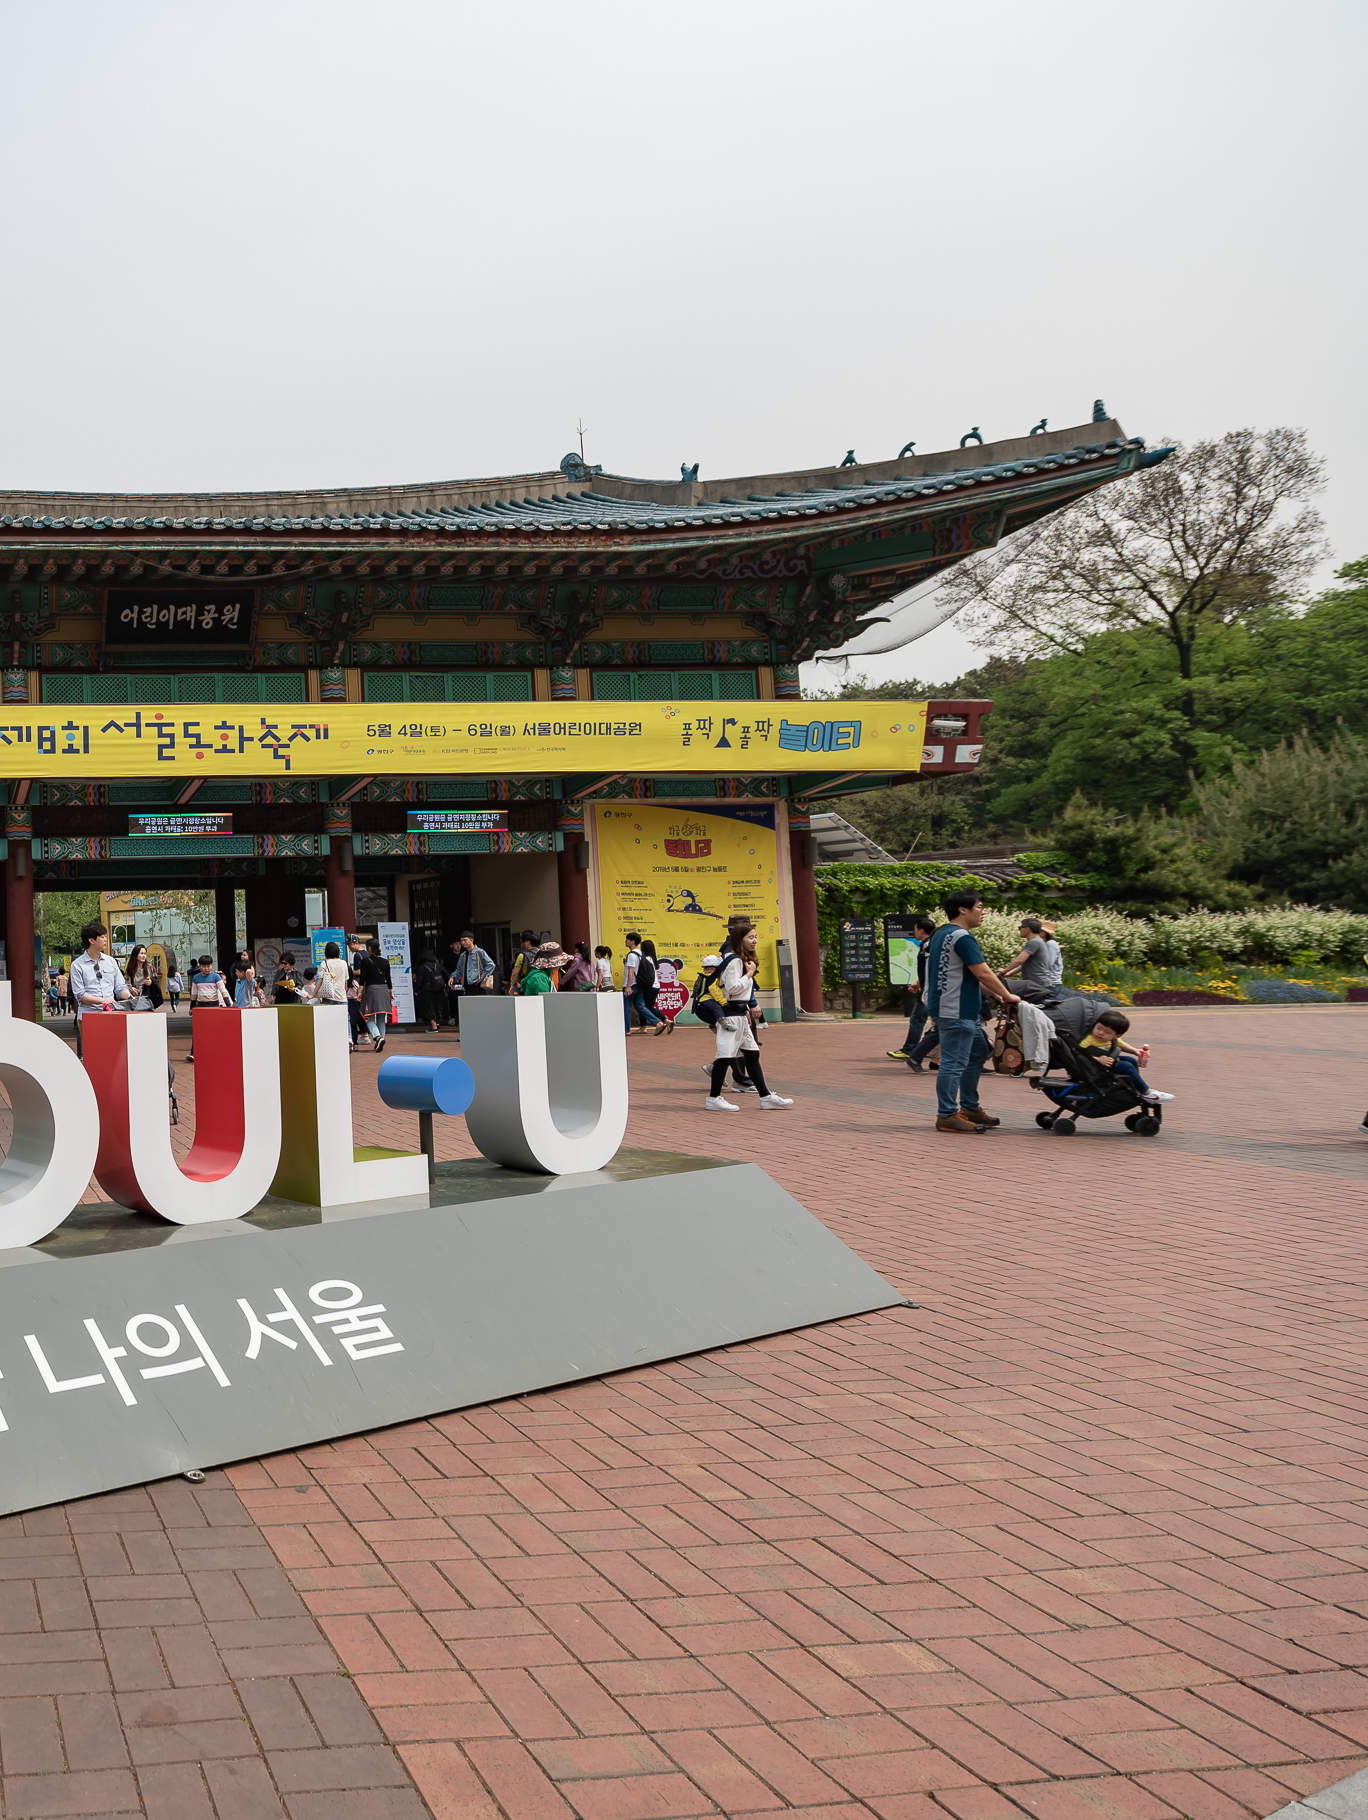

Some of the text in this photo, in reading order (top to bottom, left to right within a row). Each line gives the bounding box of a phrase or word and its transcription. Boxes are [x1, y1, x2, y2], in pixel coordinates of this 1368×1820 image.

[120, 603, 241, 630] 어린이대공원
[100, 711, 330, 771] 서울동화축제
[366, 723, 393, 738] 5월
[397, 723, 447, 739] 4일(토)
[467, 723, 517, 738] 6일(월)
[522, 721, 643, 737] 서울어린이대공원
[681, 716, 774, 750] 폴짝 폴짝
[778, 719, 862, 752] 놀이터
[663, 838, 712, 859] 동화나라
[458, 991, 629, 1175] U
[23, 1303, 232, 1407] 나의
[236, 1279, 405, 1367] 서울
